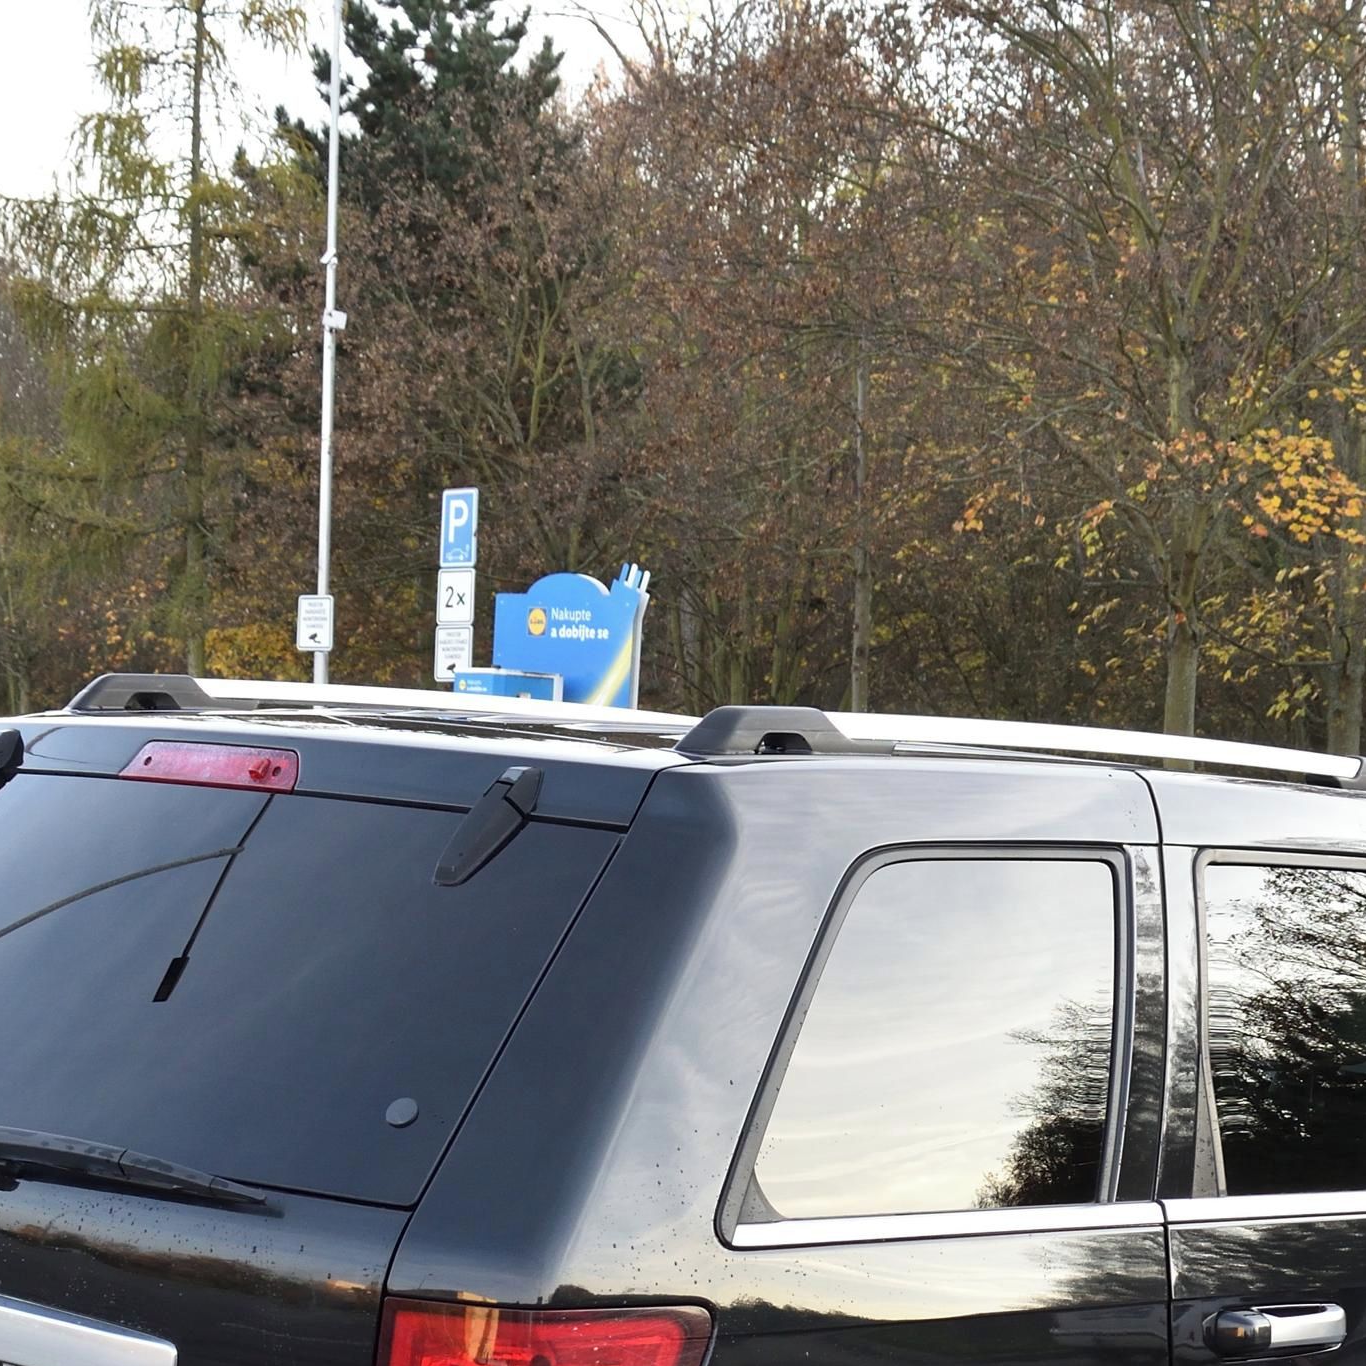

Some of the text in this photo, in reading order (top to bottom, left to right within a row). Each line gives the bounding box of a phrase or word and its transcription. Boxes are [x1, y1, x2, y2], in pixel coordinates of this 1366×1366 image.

[447, 498, 469, 543] P
[551, 607, 592, 624] Nakupte
[550, 624, 609, 642] a dobijte se
